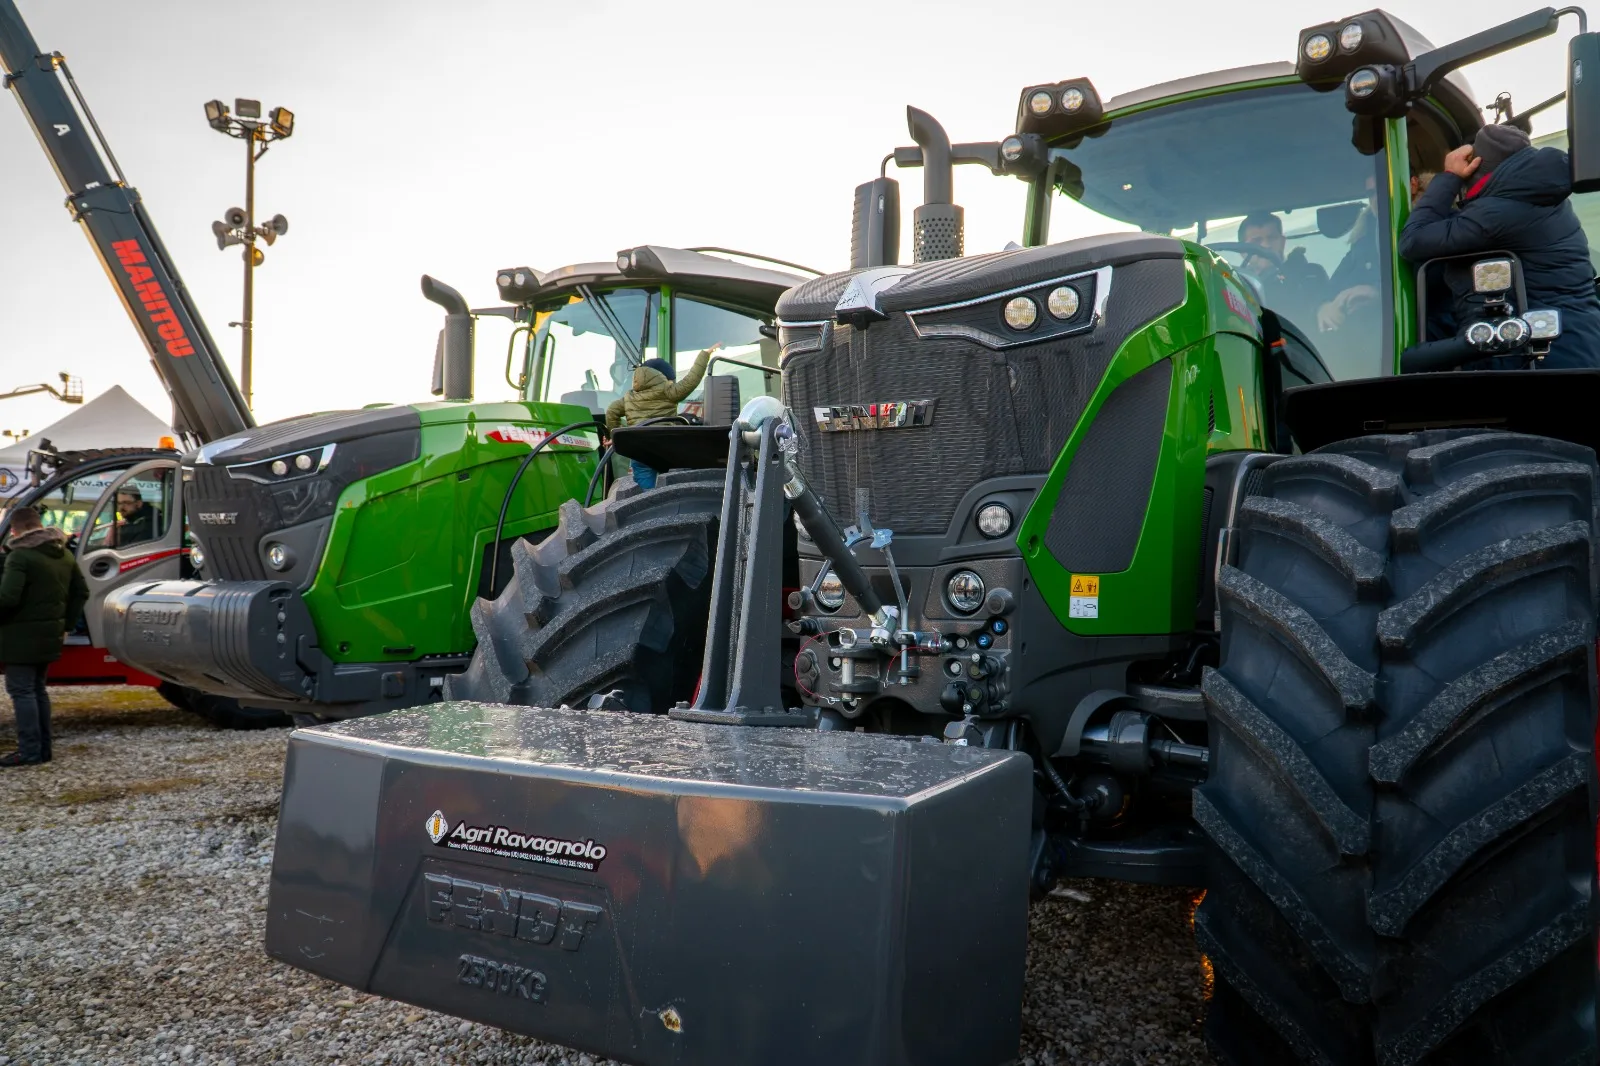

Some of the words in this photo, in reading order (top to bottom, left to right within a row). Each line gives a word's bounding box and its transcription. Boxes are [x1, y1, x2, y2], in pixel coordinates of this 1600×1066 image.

[112, 239, 195, 358] MANITOU
[497, 426, 547, 442] FENDT
[813, 399, 937, 432] FENDT
[450, 822, 494, 844] Agri
[493, 827, 606, 860] Ravagnolo
[424, 873, 602, 952] FENDT
[458, 954, 547, 1003] 2500KG
